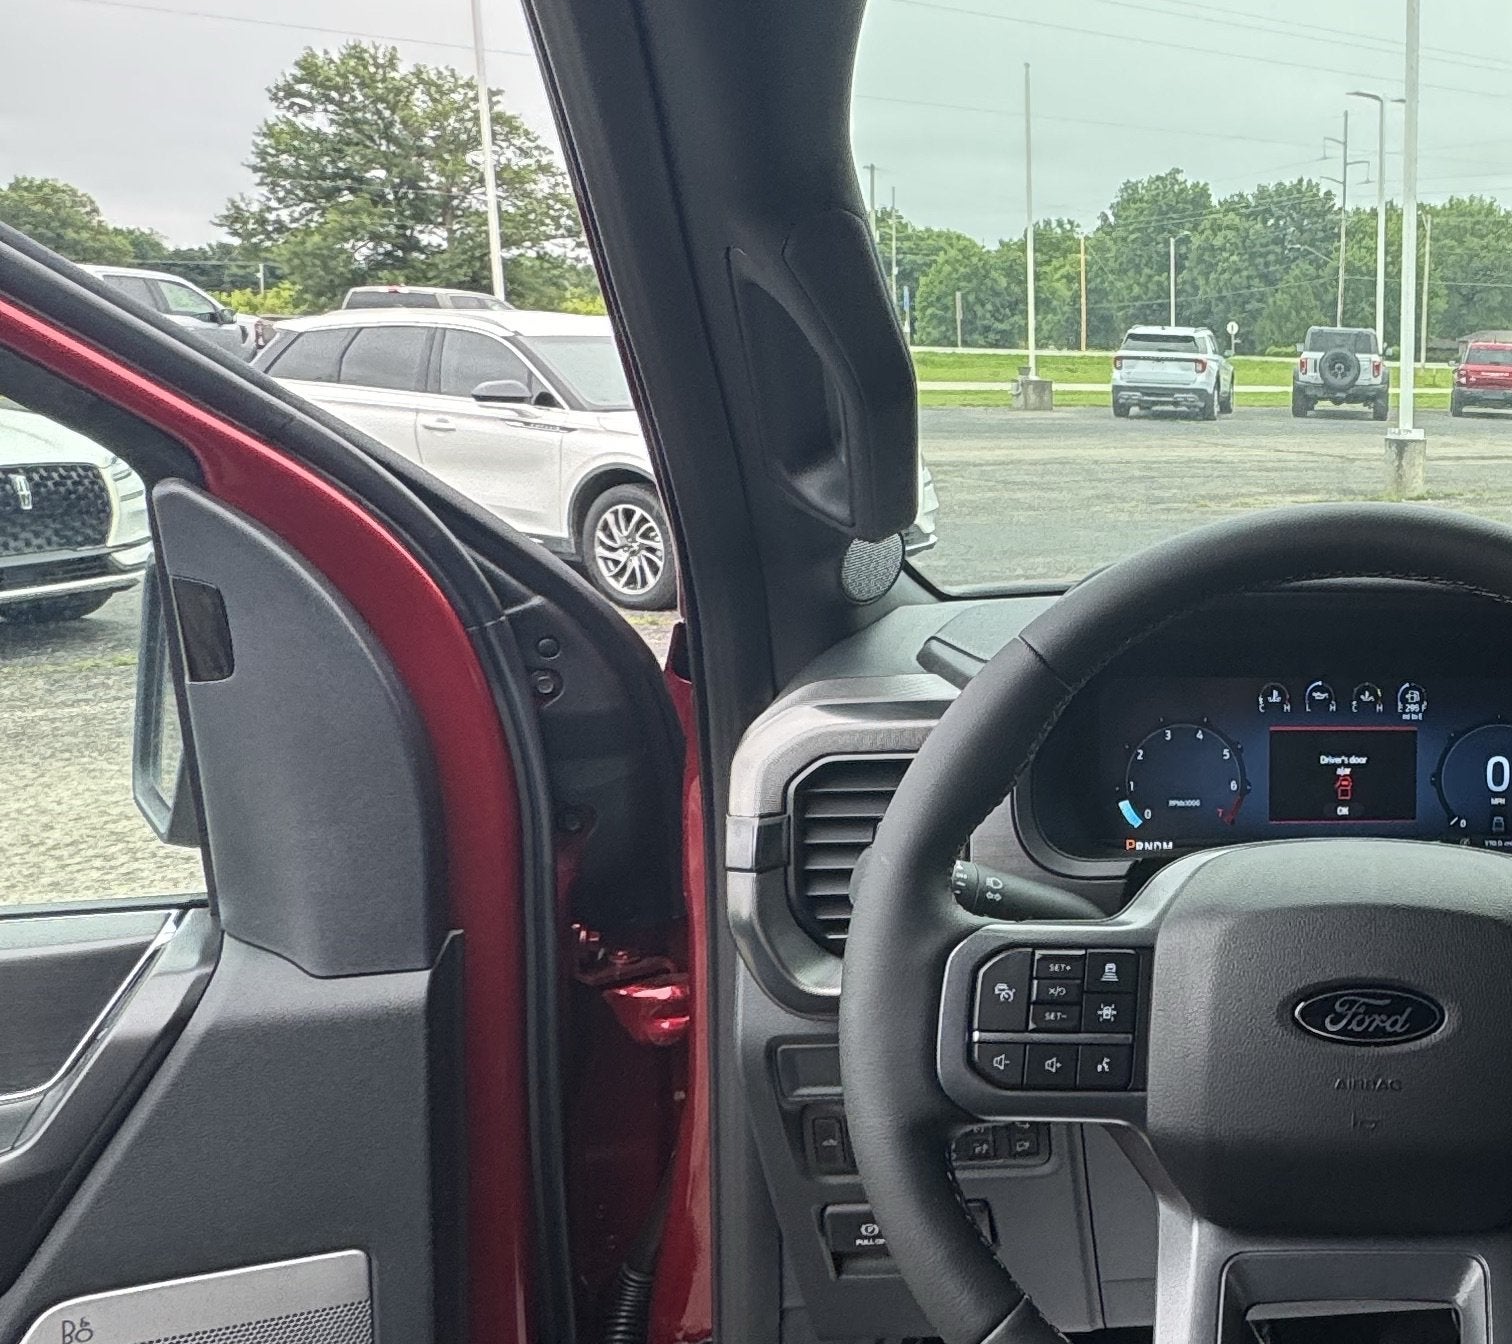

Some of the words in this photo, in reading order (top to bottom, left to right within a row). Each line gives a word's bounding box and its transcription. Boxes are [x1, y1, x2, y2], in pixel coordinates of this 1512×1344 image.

[1320, 755, 1348, 765] Driver's
[1349, 755, 1368, 765] door
[1336, 766, 1352, 777] ajar
[1486, 755, 1511, 793] 0
[1490, 797, 1506, 806] MPH
[1336, 806, 1350, 816] OK
[1324, 995, 1413, 1033] Ford
[855, 1238, 875, 1247] PULL
